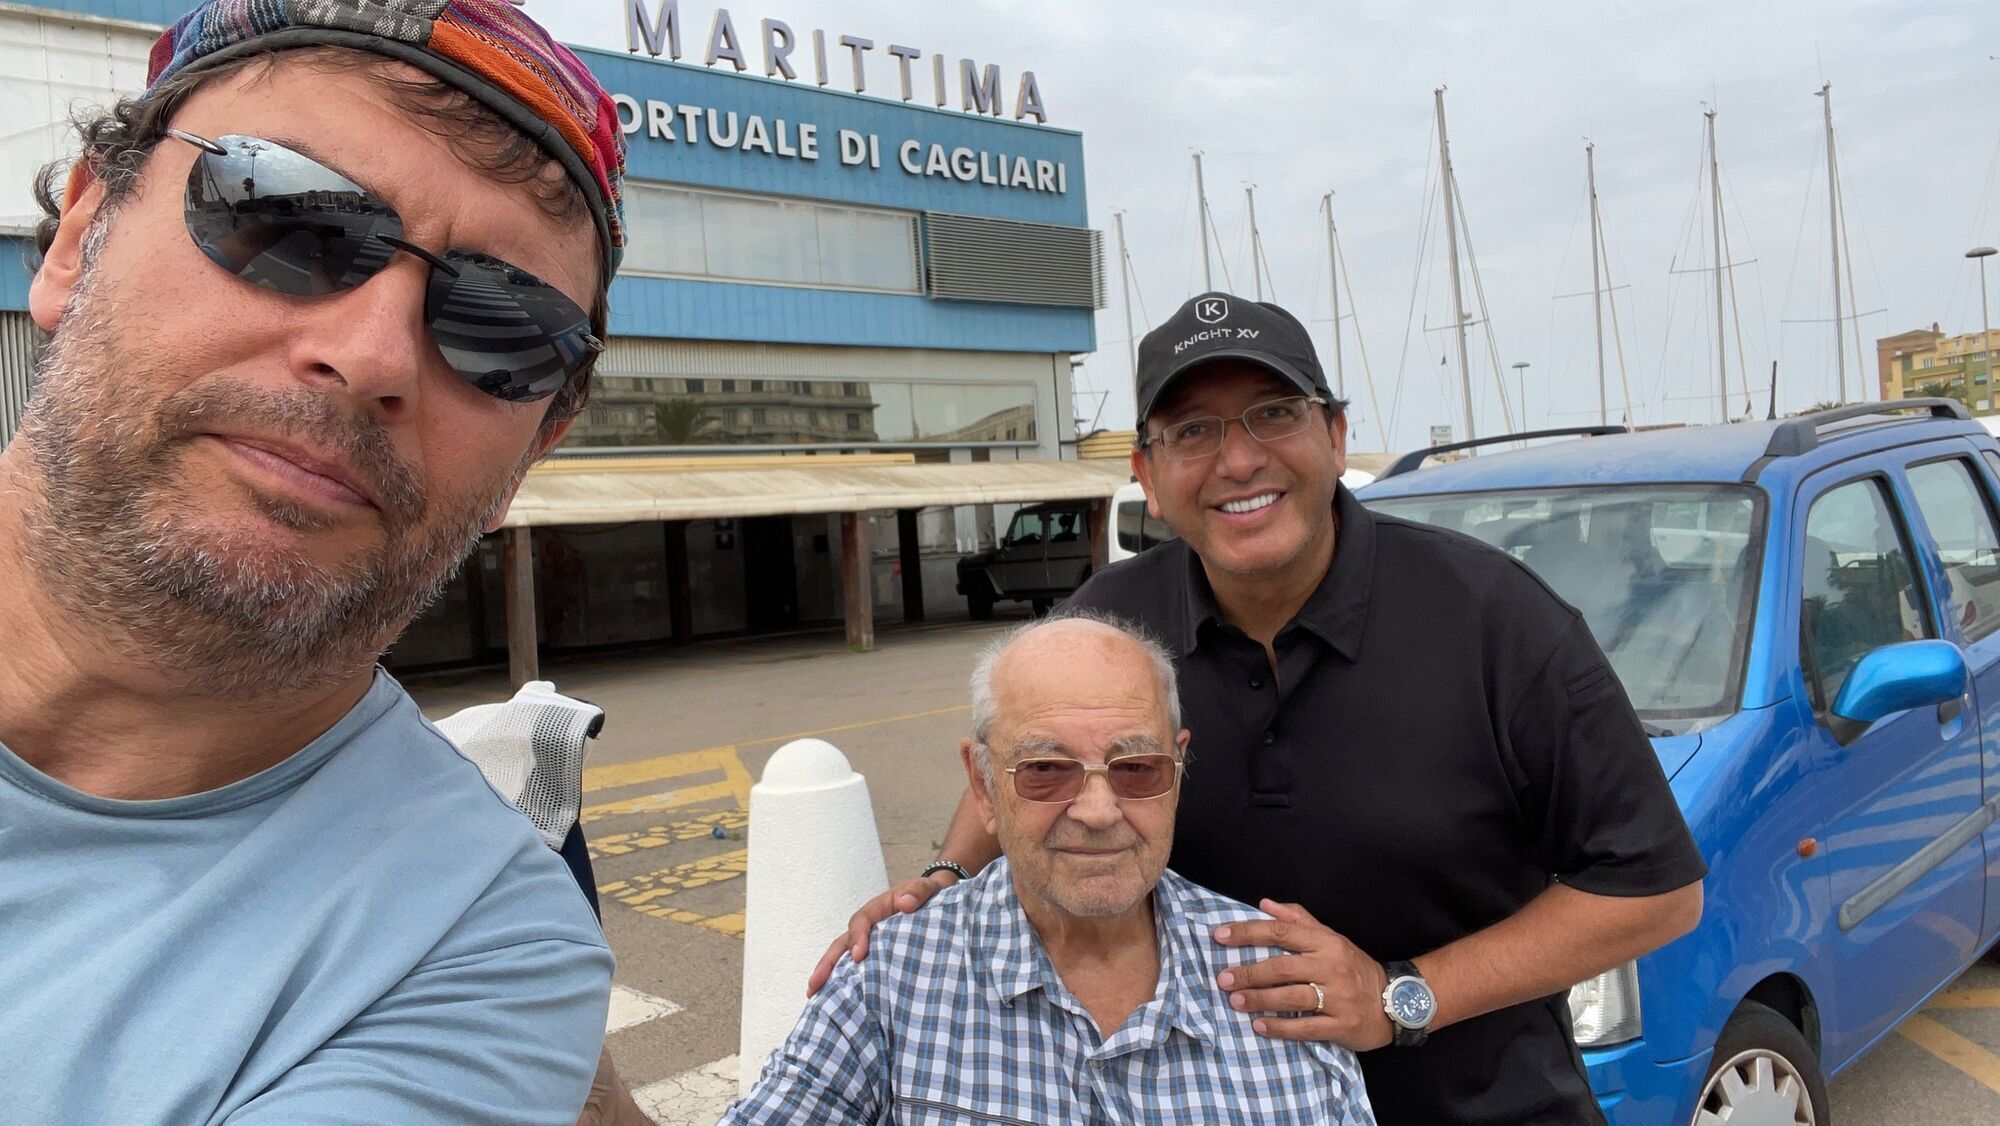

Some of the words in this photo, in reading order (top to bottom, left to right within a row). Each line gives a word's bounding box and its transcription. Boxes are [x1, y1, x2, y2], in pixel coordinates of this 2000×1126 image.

[624, 0, 1047, 123] MARITTIMA
[611, 93, 819, 159] ORTUALE
[840, 129, 880, 168] DI
[900, 139, 1067, 194] CAGLIARI
[1205, 302, 1221, 316] K
[1174, 328, 1232, 355] KNIGHT
[1236, 328, 1260, 339] XV
